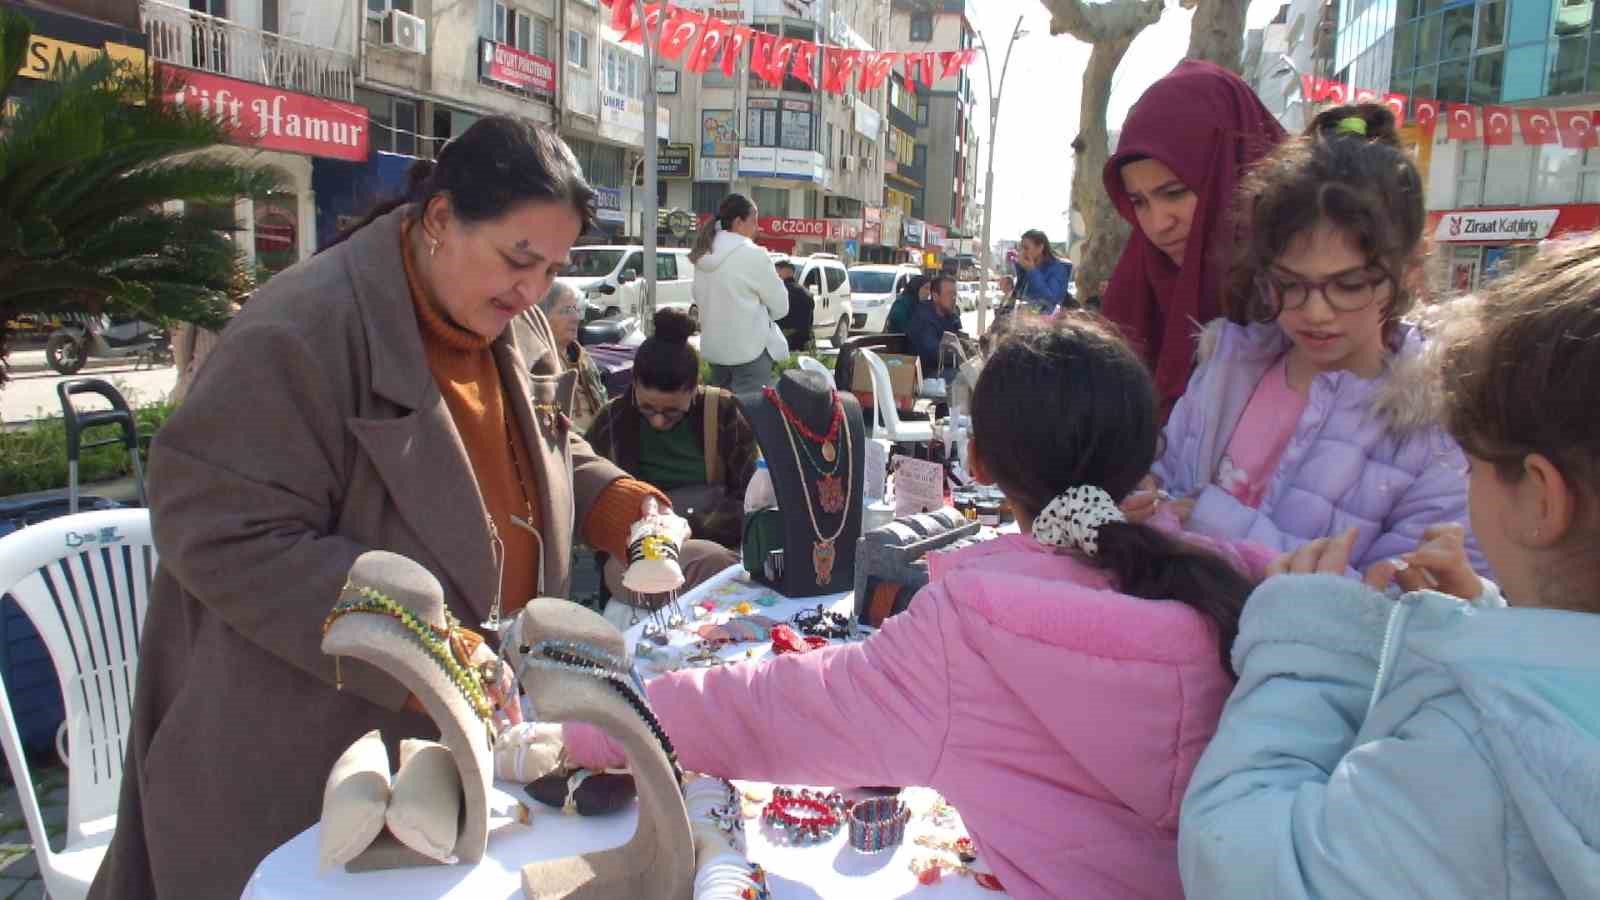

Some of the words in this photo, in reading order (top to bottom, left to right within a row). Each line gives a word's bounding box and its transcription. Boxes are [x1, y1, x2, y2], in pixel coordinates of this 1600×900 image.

[250, 95, 363, 147] Hamur
[771, 219, 824, 234] eczane
[1463, 218, 1497, 233] Ziraat
